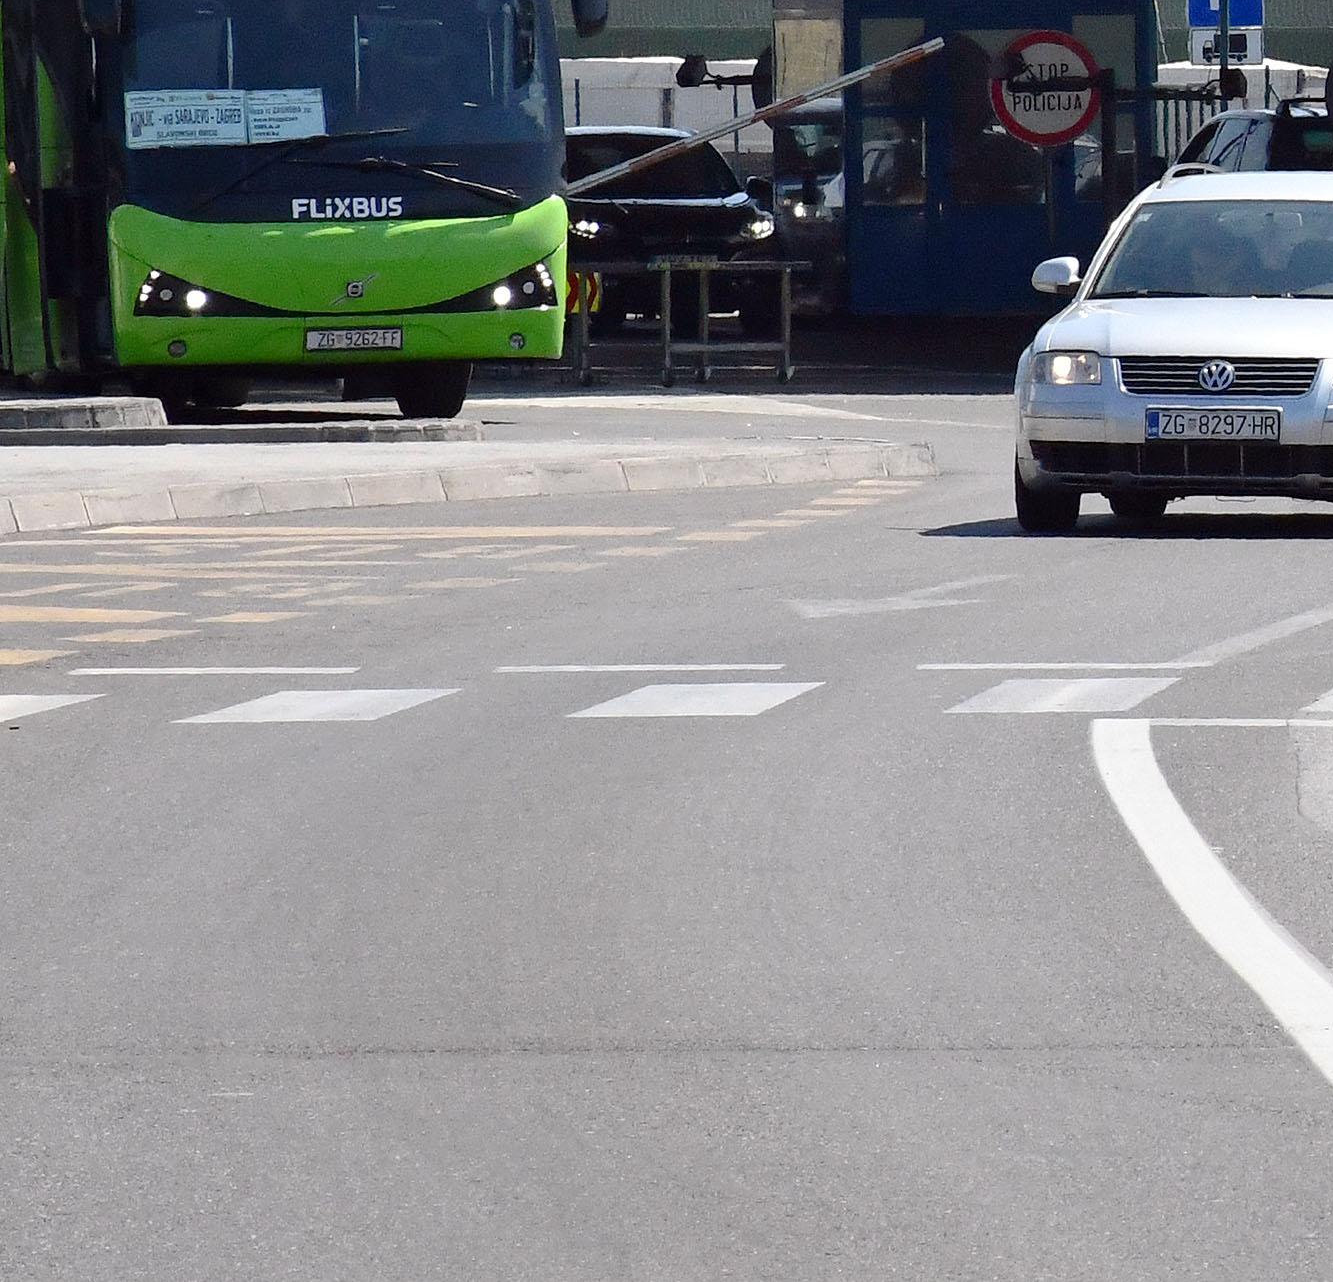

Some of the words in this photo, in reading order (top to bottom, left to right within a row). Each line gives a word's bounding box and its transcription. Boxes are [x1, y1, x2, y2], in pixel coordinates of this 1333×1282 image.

[1012, 93, 1082, 112] POLICIJA
[317, 332, 336, 347] ZG
[344, 330, 399, 347] 9262-FF
[1161, 414, 1185, 434] ZG
[1198, 415, 1276, 435] 8297-HR
